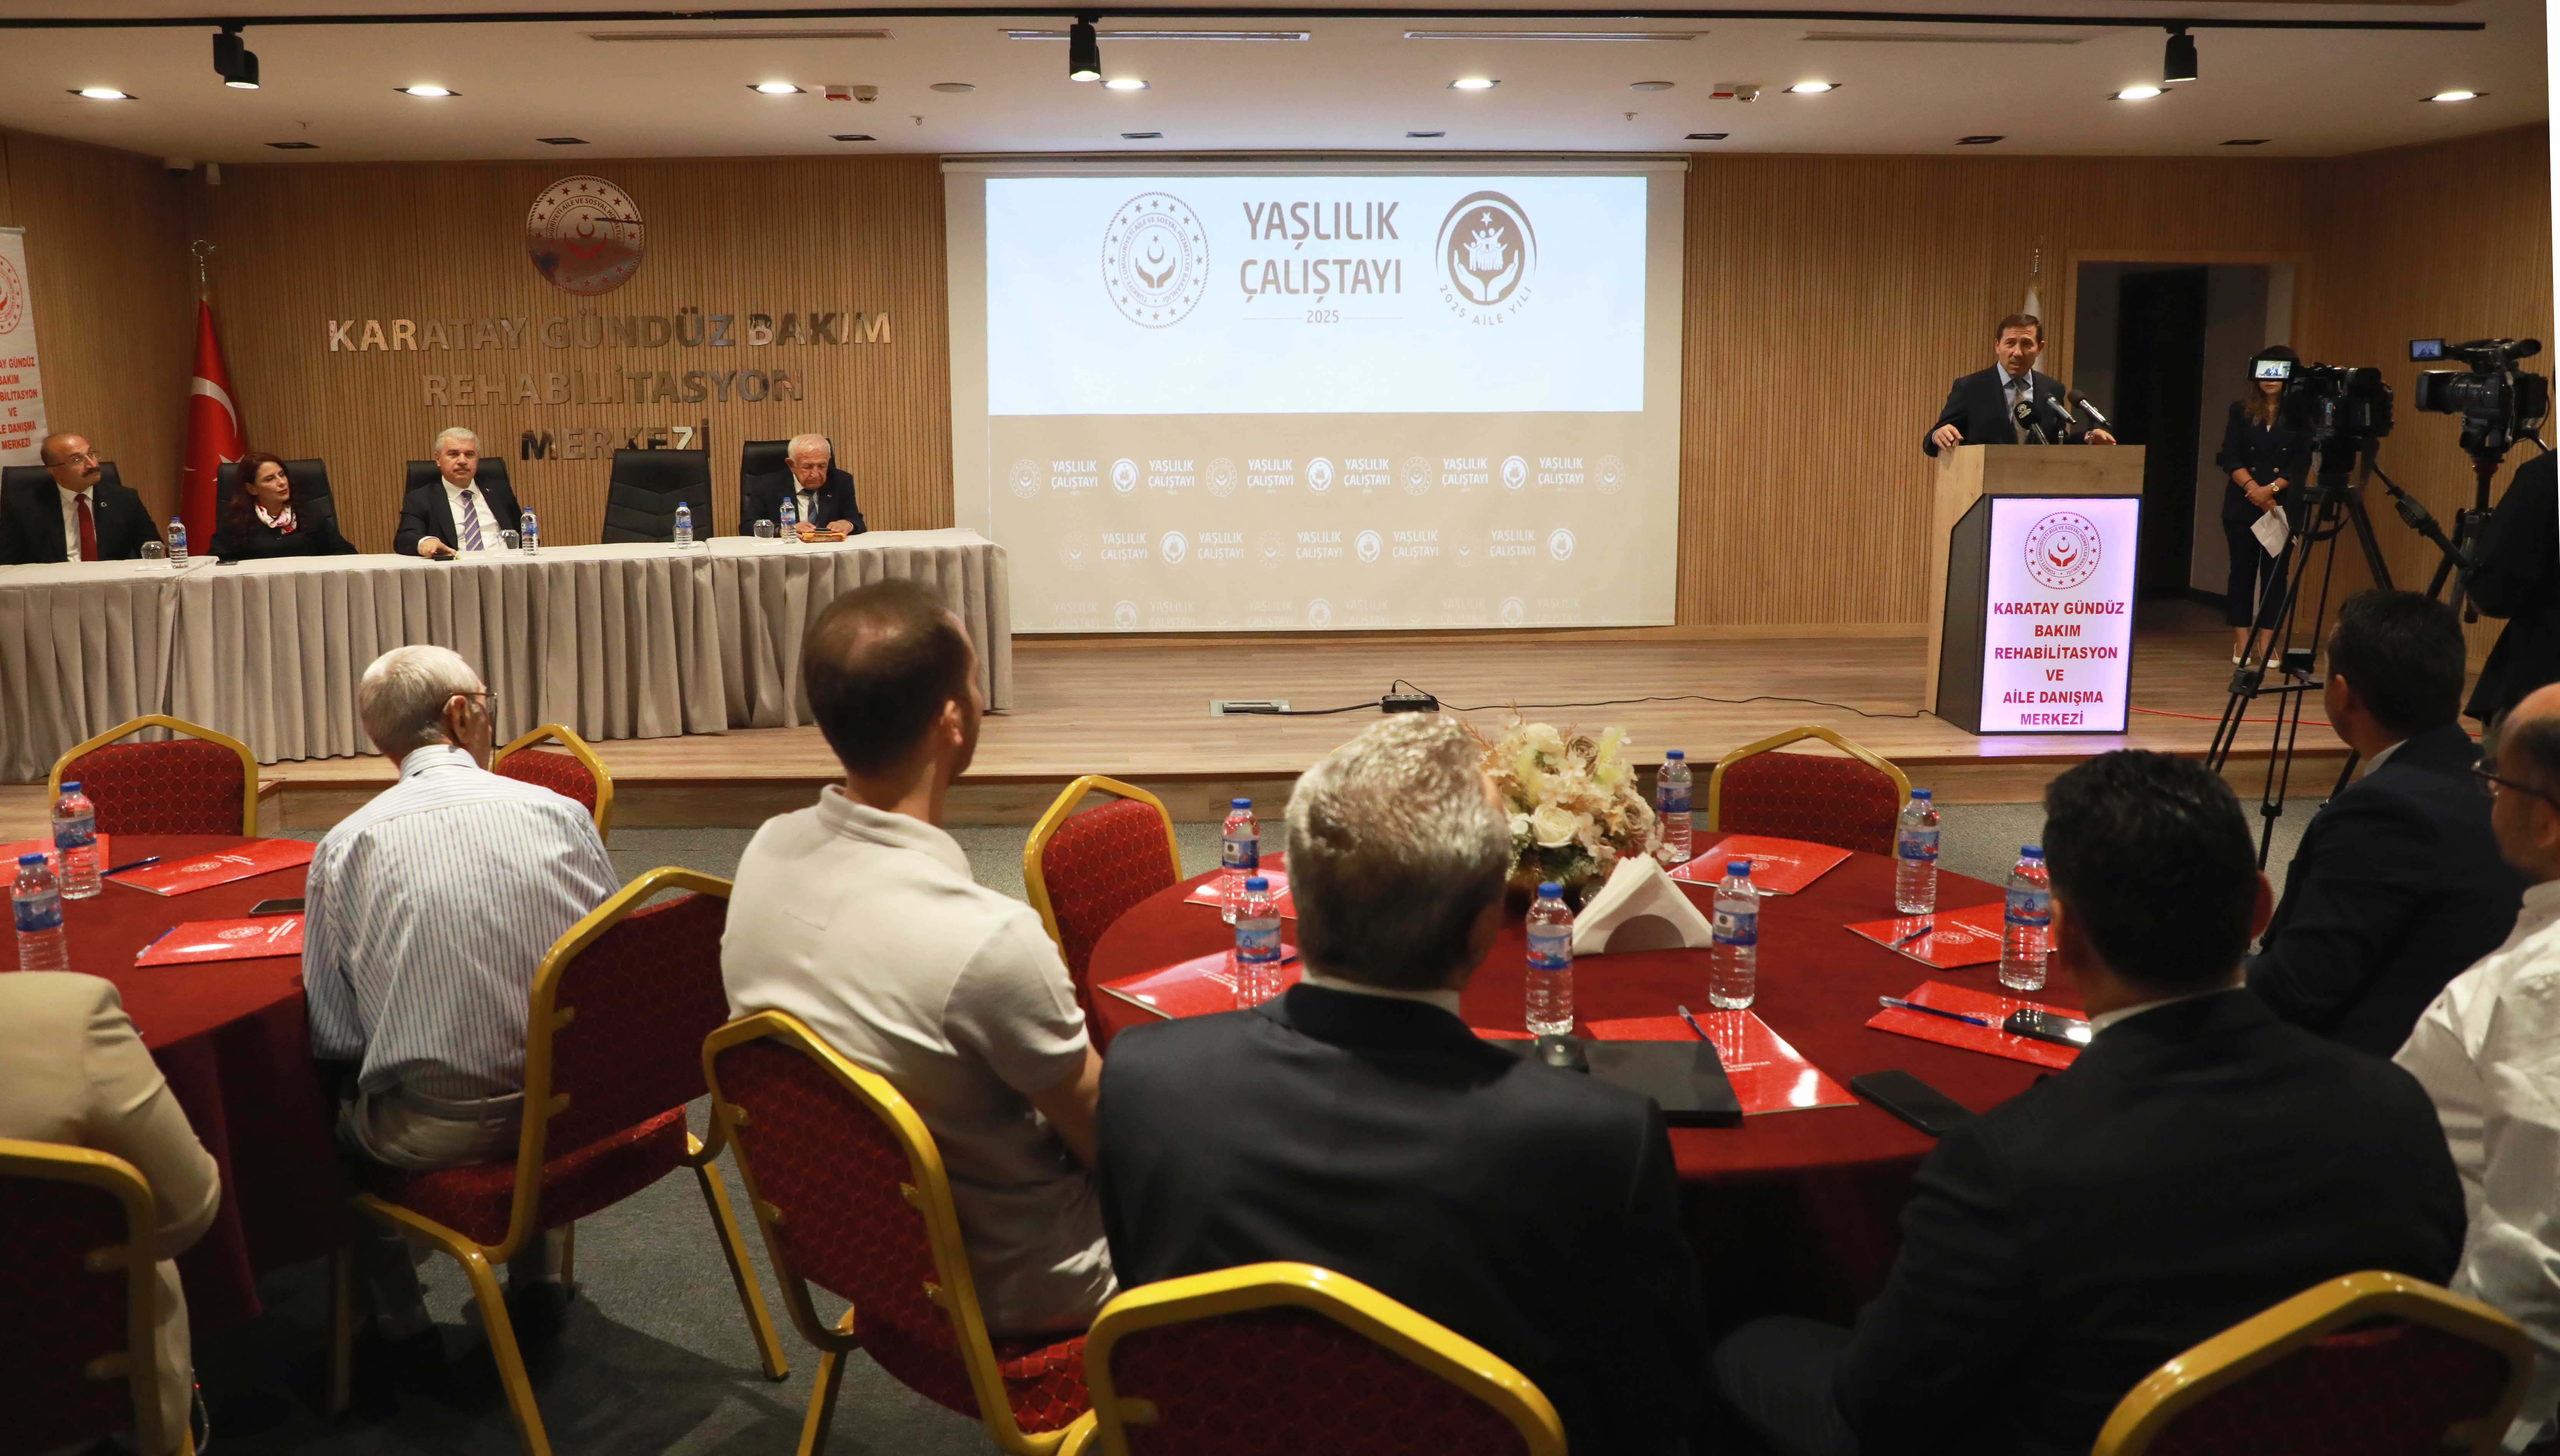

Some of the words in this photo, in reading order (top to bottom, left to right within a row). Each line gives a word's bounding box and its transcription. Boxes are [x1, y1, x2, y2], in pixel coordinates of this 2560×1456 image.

[562, 200, 575, 210] AİLE
[585, 198, 608, 211] SOSYAL
[1156, 216, 1177, 231] SOSYAL
[1243, 201, 1399, 251] YAŞLILIK
[1240, 259, 1401, 304] ÇALIŞTAYI
[1439, 284, 1466, 318] 2025
[1472, 313, 1503, 325] AİLE
[1509, 286, 1532, 315] YILI
[1307, 310, 1339, 323] 2025
[329, 316, 528, 352] KARATAY
[541, 306, 735, 349] GÜNDÜZ
[748, 312, 891, 346] BAKIM
[9, 355, 36, 369] GÜNDÜZ
[423, 364, 802, 407] REHABİLİTASYON
[0, 388, 38, 402] BİLİTASYON
[8, 407, 18, 417] VE
[8, 420, 37, 434] DANIŞMA
[2, 435, 31, 450] MERKEZİ
[521, 418, 710, 460] MERKEZİ
[1052, 460, 1096, 475] YAŞLILIK
[1149, 460, 1193, 474] YAŞLILIK
[1248, 459, 1292, 473] YAŞLILIK
[1345, 458, 1389, 472] YAŞLILIK
[1443, 458, 1488, 472] YAŞLILIK
[1539, 457, 1583, 471] YAŞLILIK
[1051, 476, 1097, 490] ÇALIŞTAYI
[1149, 475, 1194, 488] ÇALIŞTAYI
[1247, 475, 1293, 488] ÇALIŞTAYI
[1344, 474, 1390, 487] ÇALIŞTAYI
[1442, 473, 1488, 486] ÇALIŞTAYI
[1538, 473, 1584, 486] ÇALIŞTAYI
[1102, 533, 1146, 547] YAŞLILIK
[1199, 532, 1243, 546] YAŞLILIK
[1297, 531, 1341, 545] YAŞLILIK
[1393, 531, 1438, 545] YAŞLILIK
[1491, 530, 1535, 543] YAŞLILIK
[2065, 525, 2079, 534] SOSYAL
[2079, 533, 2088, 557] HİZMETLER
[1101, 549, 1147, 561] ÇALIŞTAYI
[1198, 548, 1244, 560] ÇALIŞTAYI
[1296, 547, 1342, 559] ÇALIŞTAYI
[1393, 546, 1438, 559] ÇALIŞTAYI
[1490, 545, 1535, 558] ÇALIŞTAYI
[1994, 602, 2060, 615] KARATAY
[2064, 599, 2124, 614] GÜNDÜZ
[2035, 624, 2081, 637] BAKIM
[1995, 644, 2118, 659] REHABİLİTASYON
[2045, 669, 2064, 681] VE
[2002, 689, 2035, 703] AİLE
[2039, 691, 2103, 706] DANIŞMA
[2020, 710, 2084, 725] MERKEZİ
